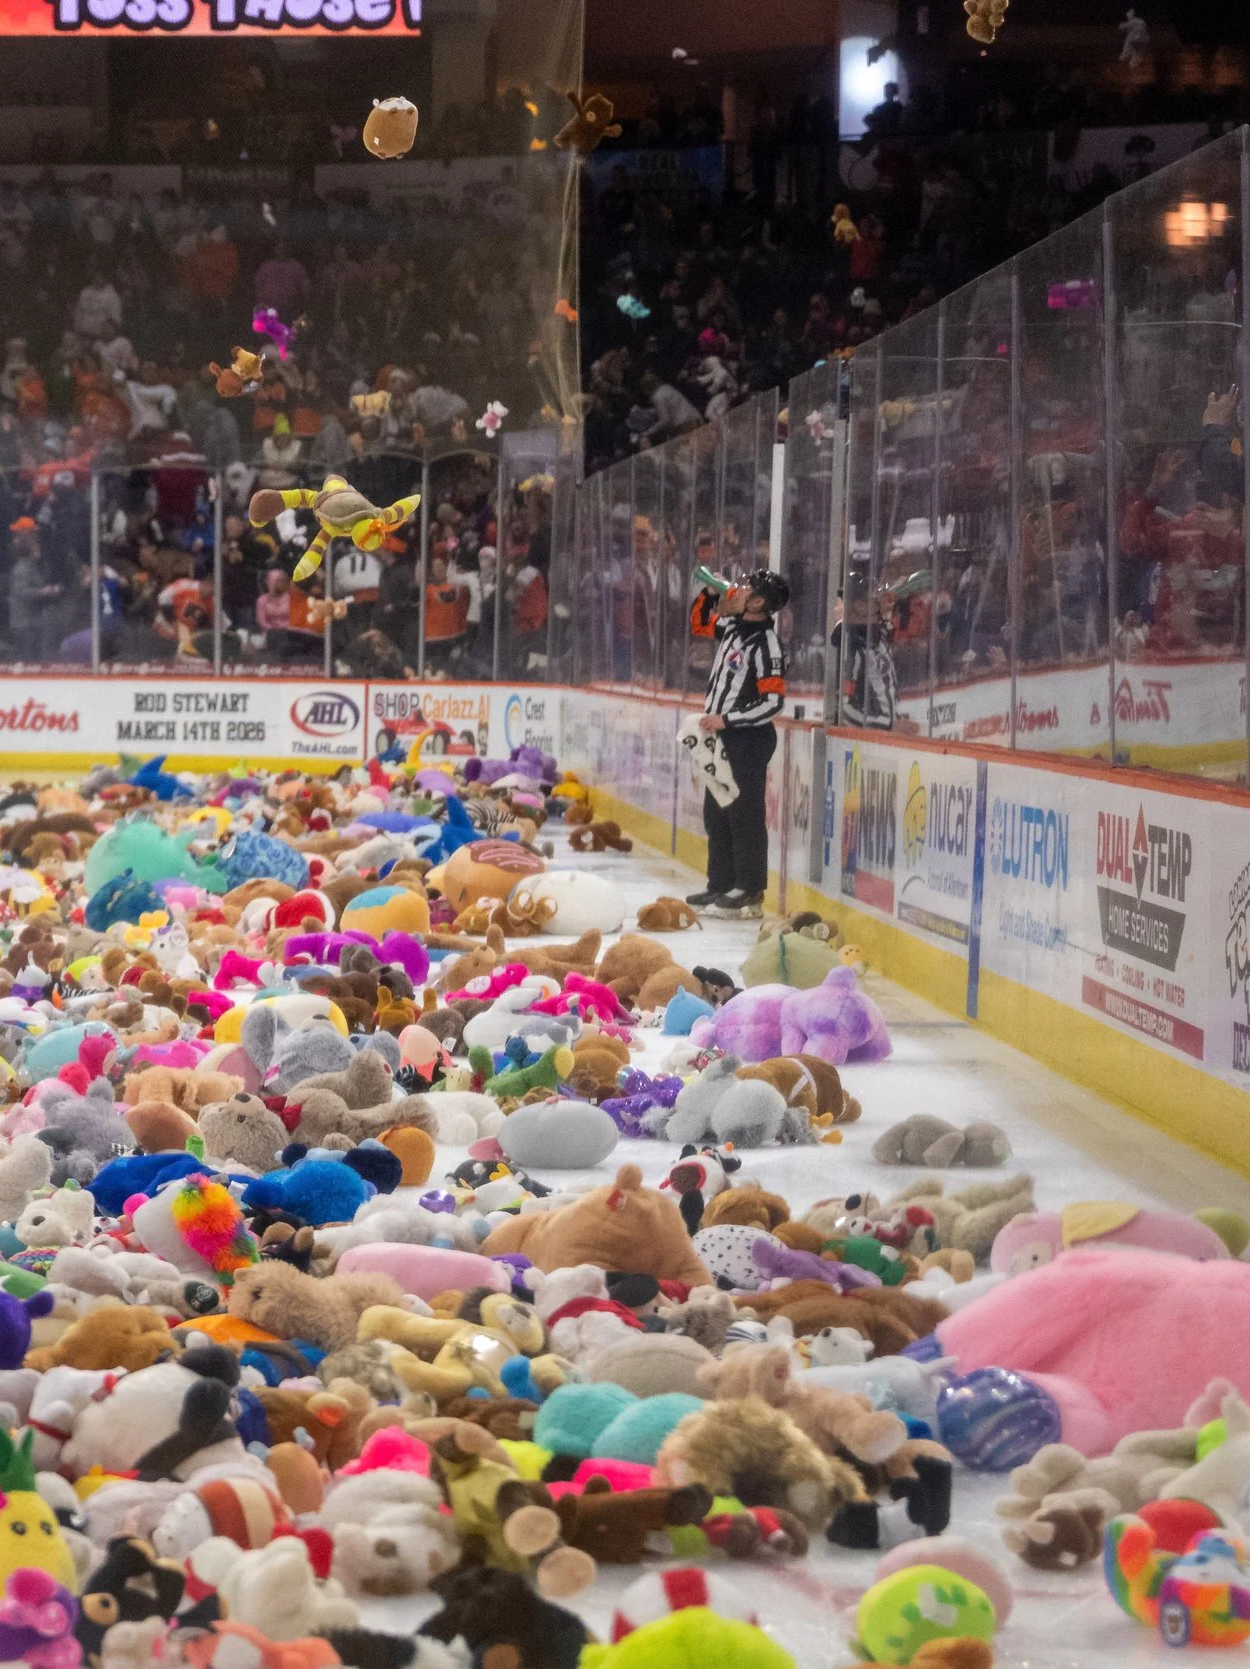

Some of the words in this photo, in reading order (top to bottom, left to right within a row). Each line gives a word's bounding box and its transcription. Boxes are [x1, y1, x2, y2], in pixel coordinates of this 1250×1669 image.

[134, 692, 167, 713] ROD
[172, 692, 250, 713] STEWART
[302, 701, 349, 726] AHL
[373, 692, 421, 718] SHOP
[524, 696, 546, 722] Crest
[116, 720, 177, 741] MARCH
[182, 720, 222, 741] 14TH
[226, 720, 266, 741] 2026
[291, 741, 358, 755] TheAHL.com
[858, 767, 897, 870] NEWS
[928, 781, 973, 857] nucar
[1001, 801, 1070, 892] LUTRON
[1096, 810, 1133, 885] DUAL
[1147, 823, 1193, 903] TEMP
[1107, 903, 1130, 940] HOME
[1131, 911, 1170, 954] SERVICES
[1165, 980, 1186, 1009] WATER
